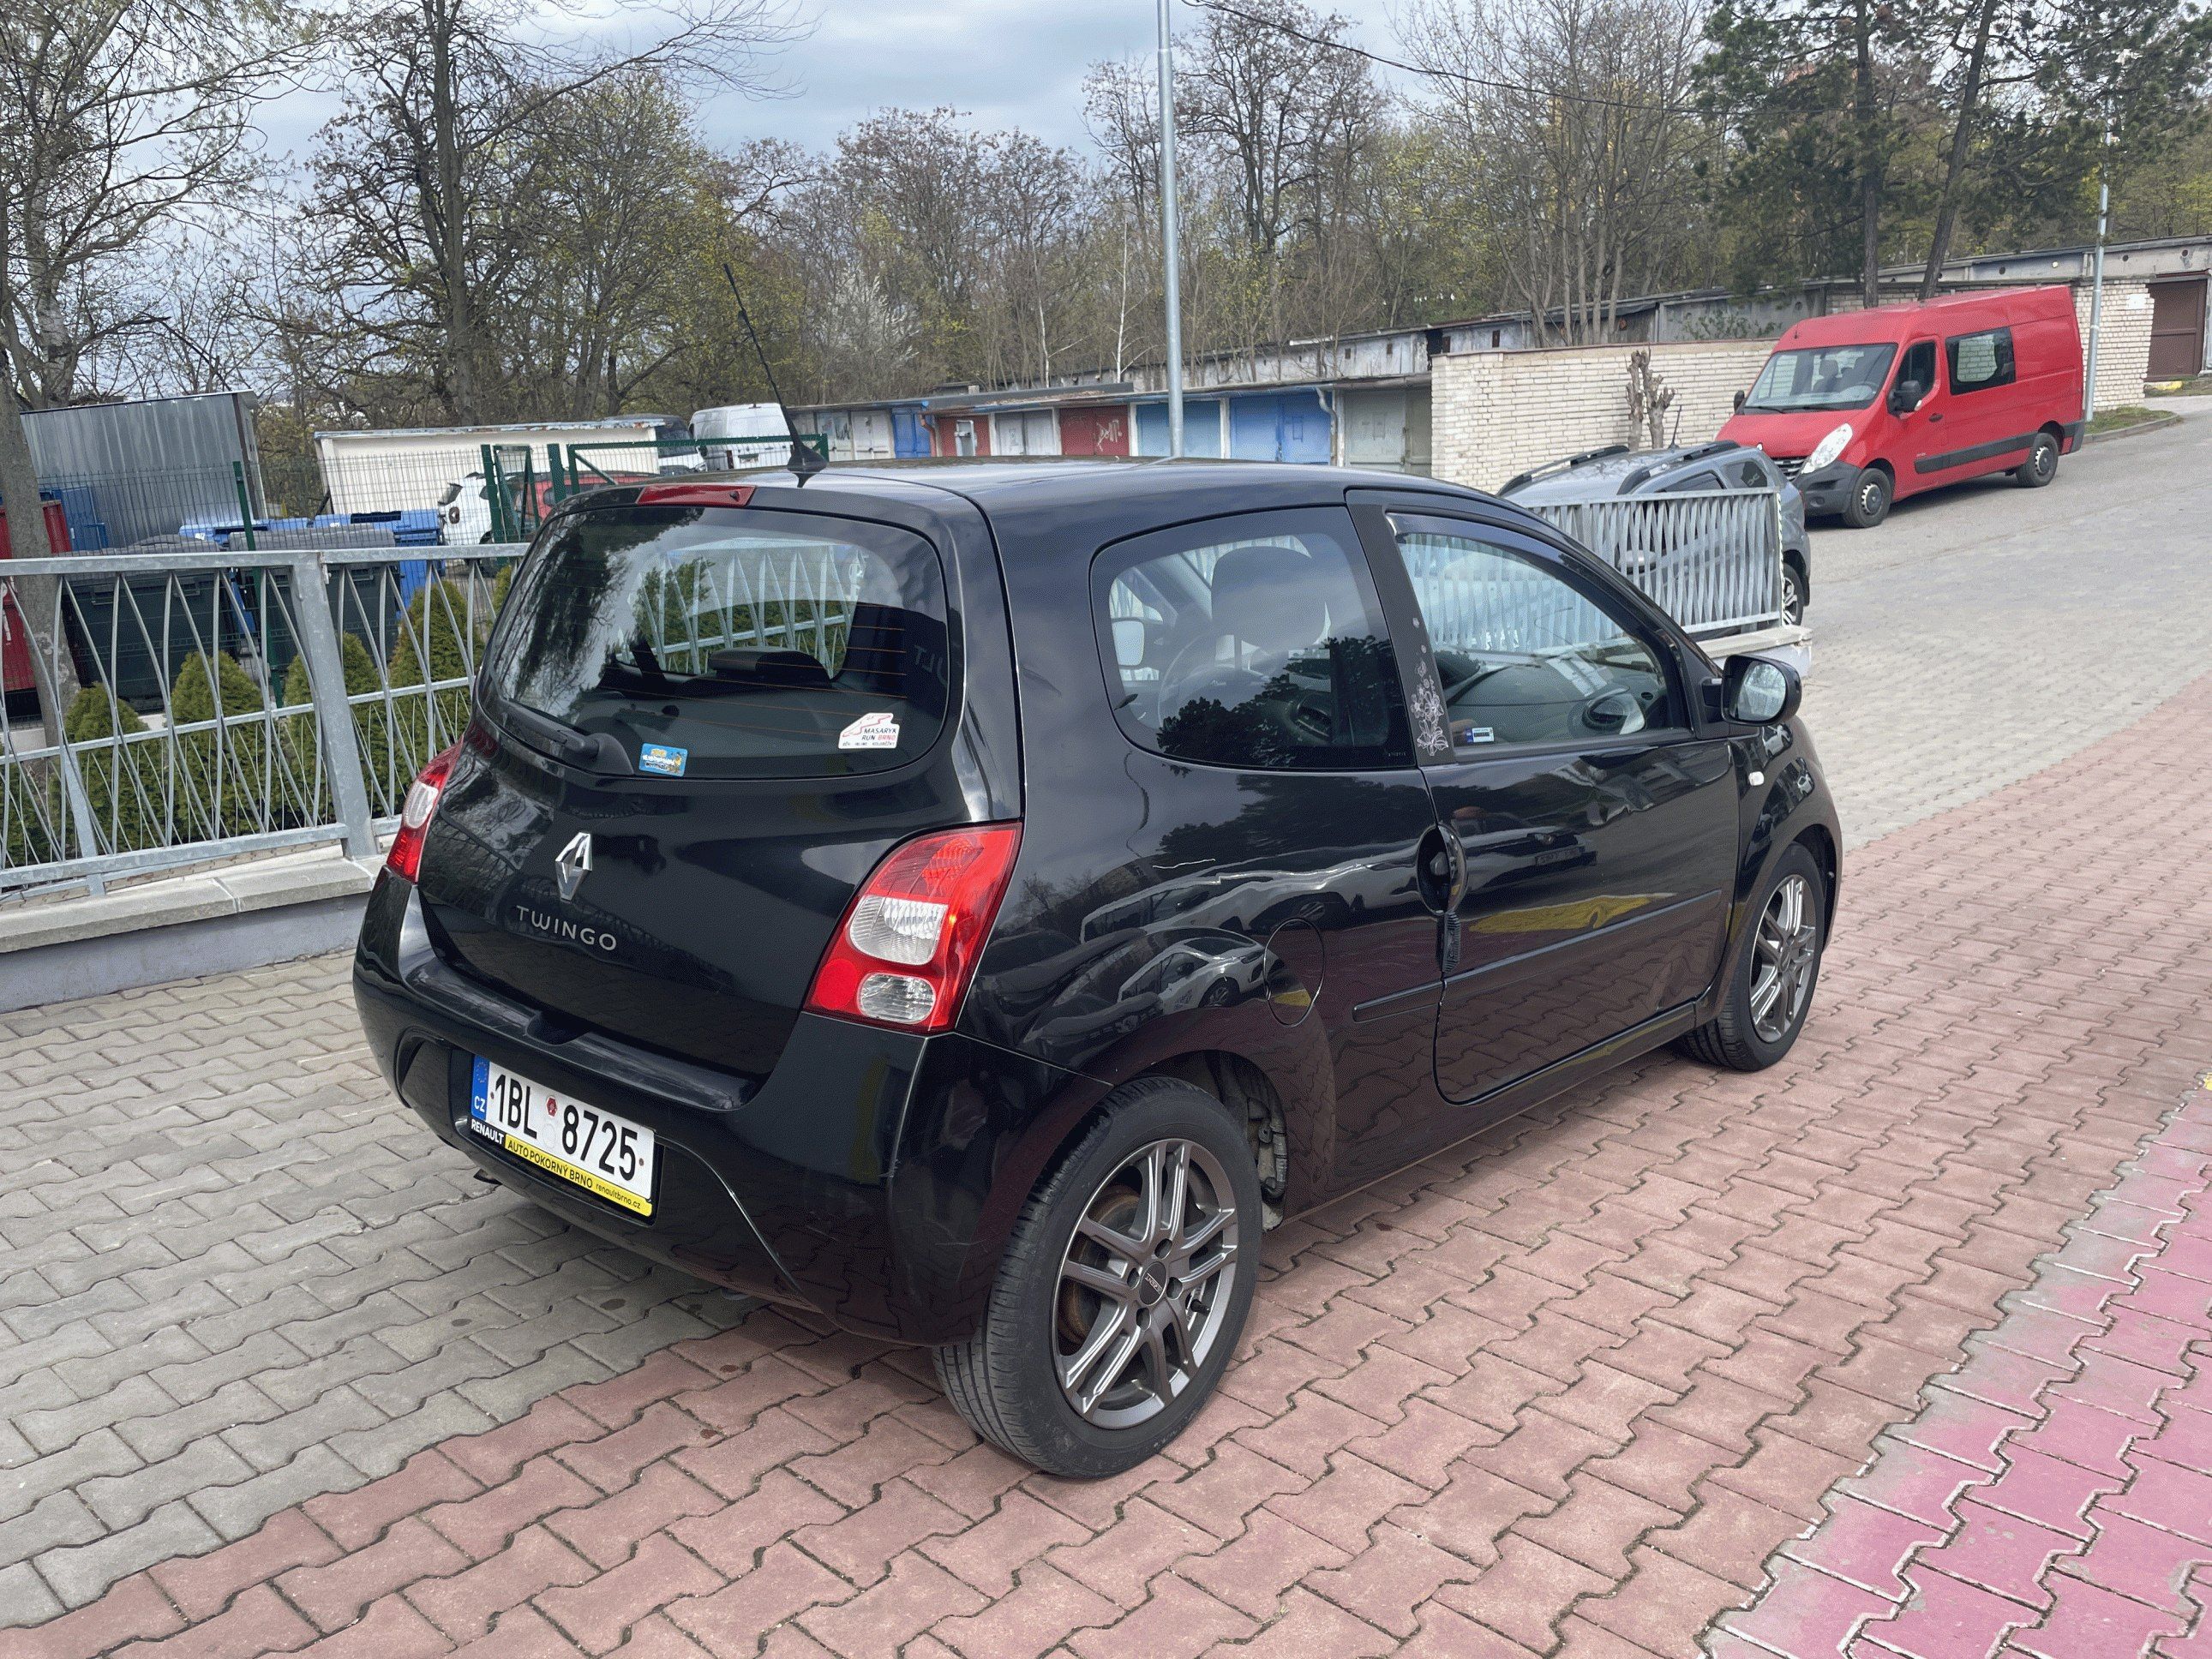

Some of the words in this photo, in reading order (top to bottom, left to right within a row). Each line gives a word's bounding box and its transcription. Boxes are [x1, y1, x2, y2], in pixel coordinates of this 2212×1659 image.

[516, 904, 617, 951] TWINGO
[474, 1095, 486, 1113] CZ
[471, 1118, 505, 1145] RENAULT
[495, 1074, 538, 1140] 1BL
[561, 1104, 638, 1182] 8725
[507, 1140, 529, 1158] AUTO
[530, 1150, 569, 1177] POKORNÝ
[569, 1169, 593, 1189] BRNO
[596, 1183, 642, 1210] renaultbrno.cz
